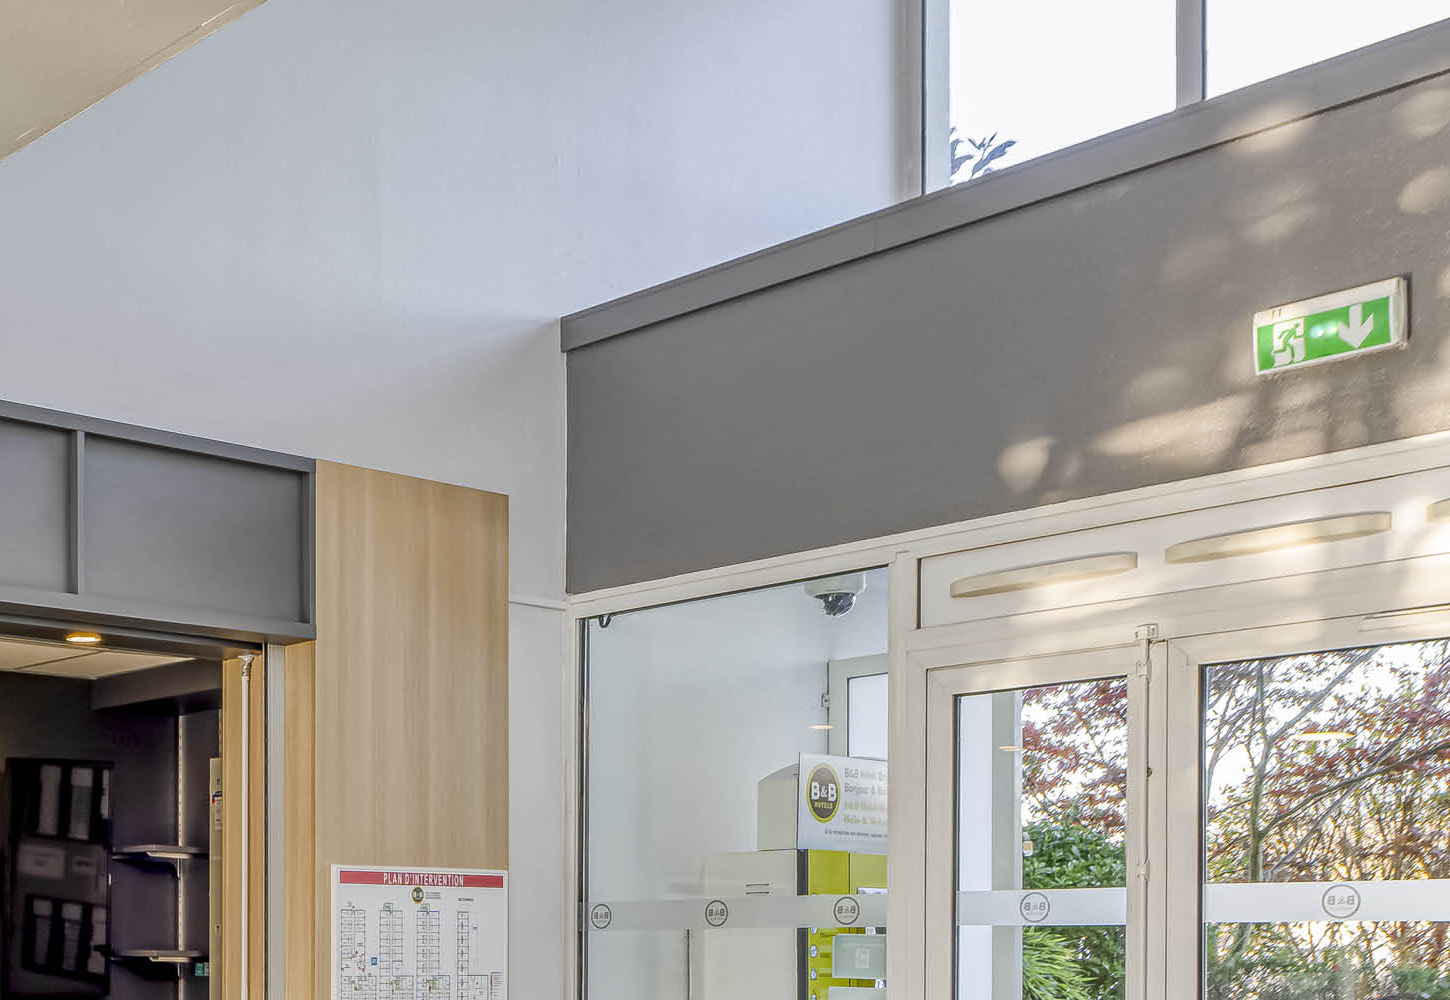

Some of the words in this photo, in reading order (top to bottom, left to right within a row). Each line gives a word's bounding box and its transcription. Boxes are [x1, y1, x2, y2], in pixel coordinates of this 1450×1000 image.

[811, 781, 837, 801] B&B
[383, 872, 403, 885] PLAN
[405, 872, 464, 887] D'INTERVENTION
